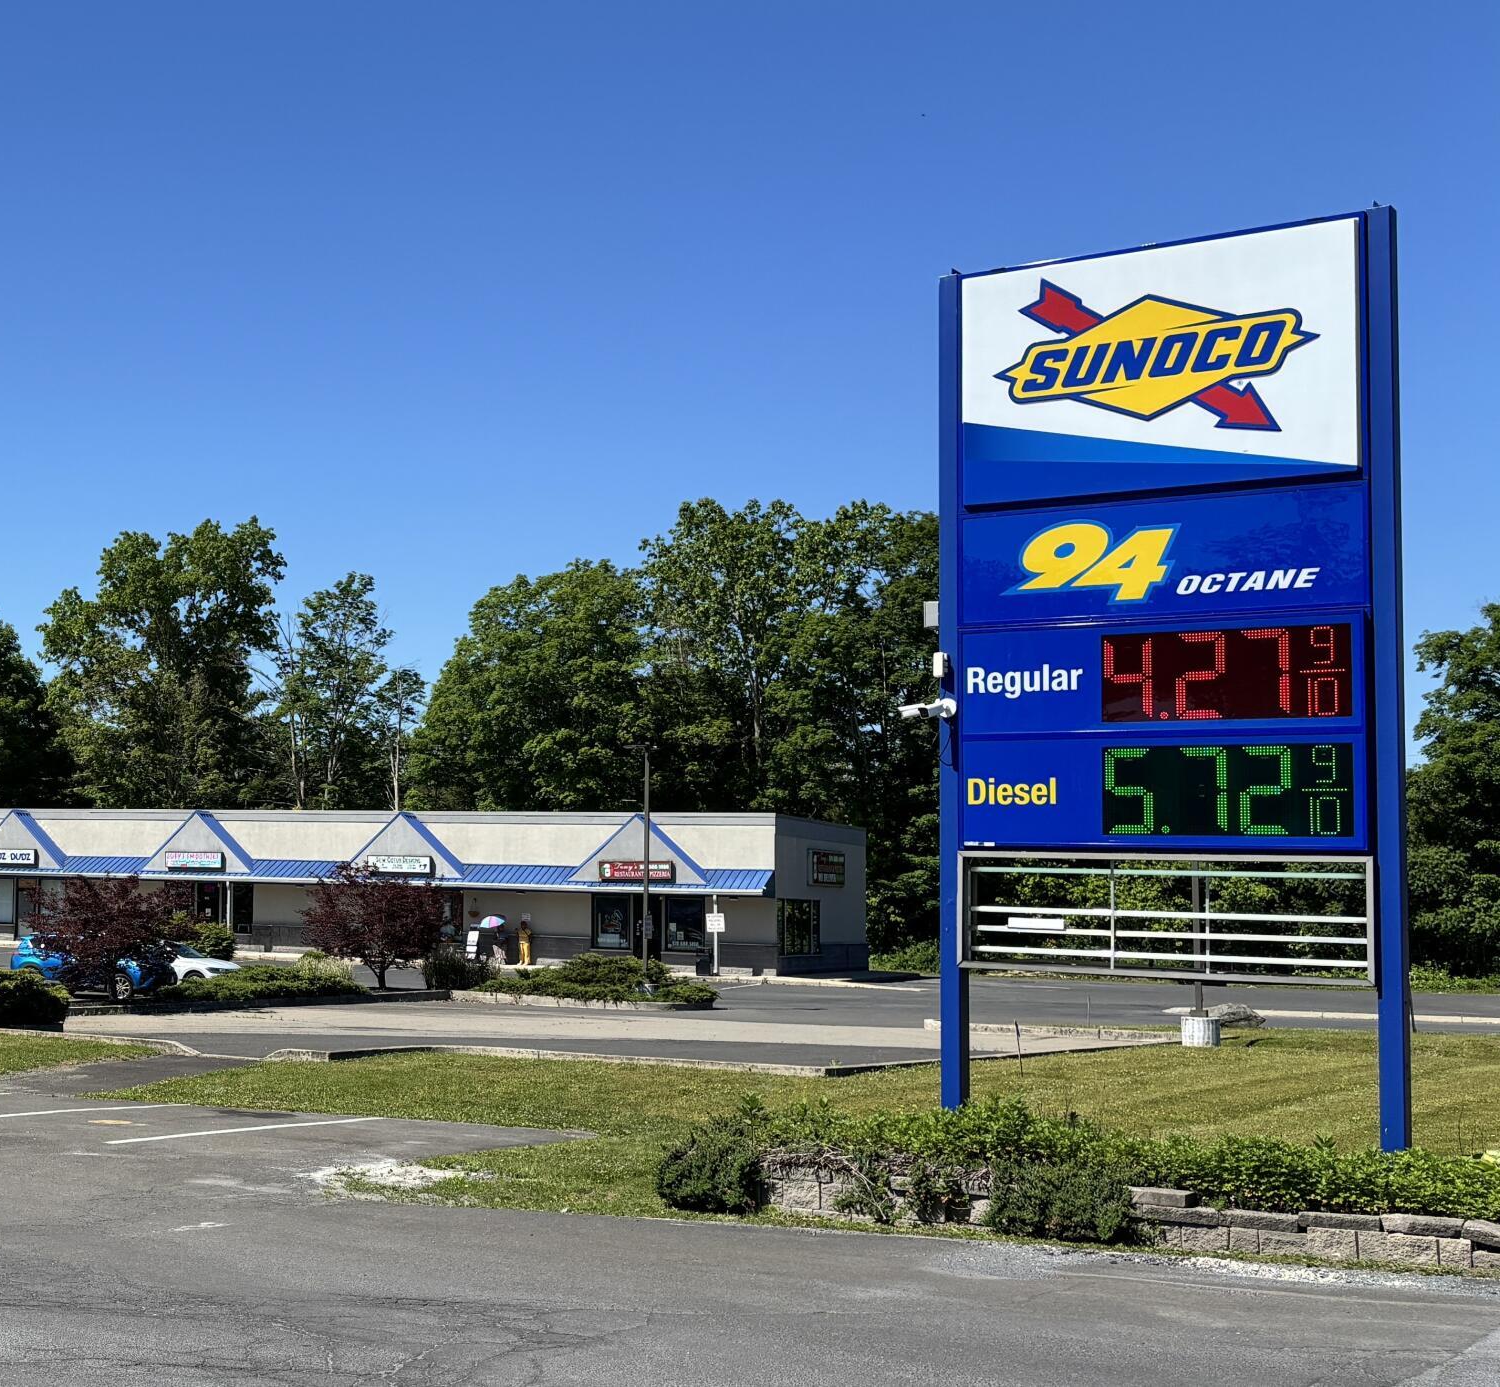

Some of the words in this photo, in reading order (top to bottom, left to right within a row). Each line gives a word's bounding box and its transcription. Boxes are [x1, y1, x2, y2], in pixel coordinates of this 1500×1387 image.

[1021, 319, 1286, 394] SUNOCO
[1004, 519, 1179, 604] 94
[1176, 567, 1320, 596] OCTANE
[966, 664, 1083, 699] Regular
[1102, 627, 1291, 720] 4.27
[966, 777, 1058, 806] Diesel
[1104, 746, 1292, 836] 5.72
[10, 852, 31, 861] DUDZ
